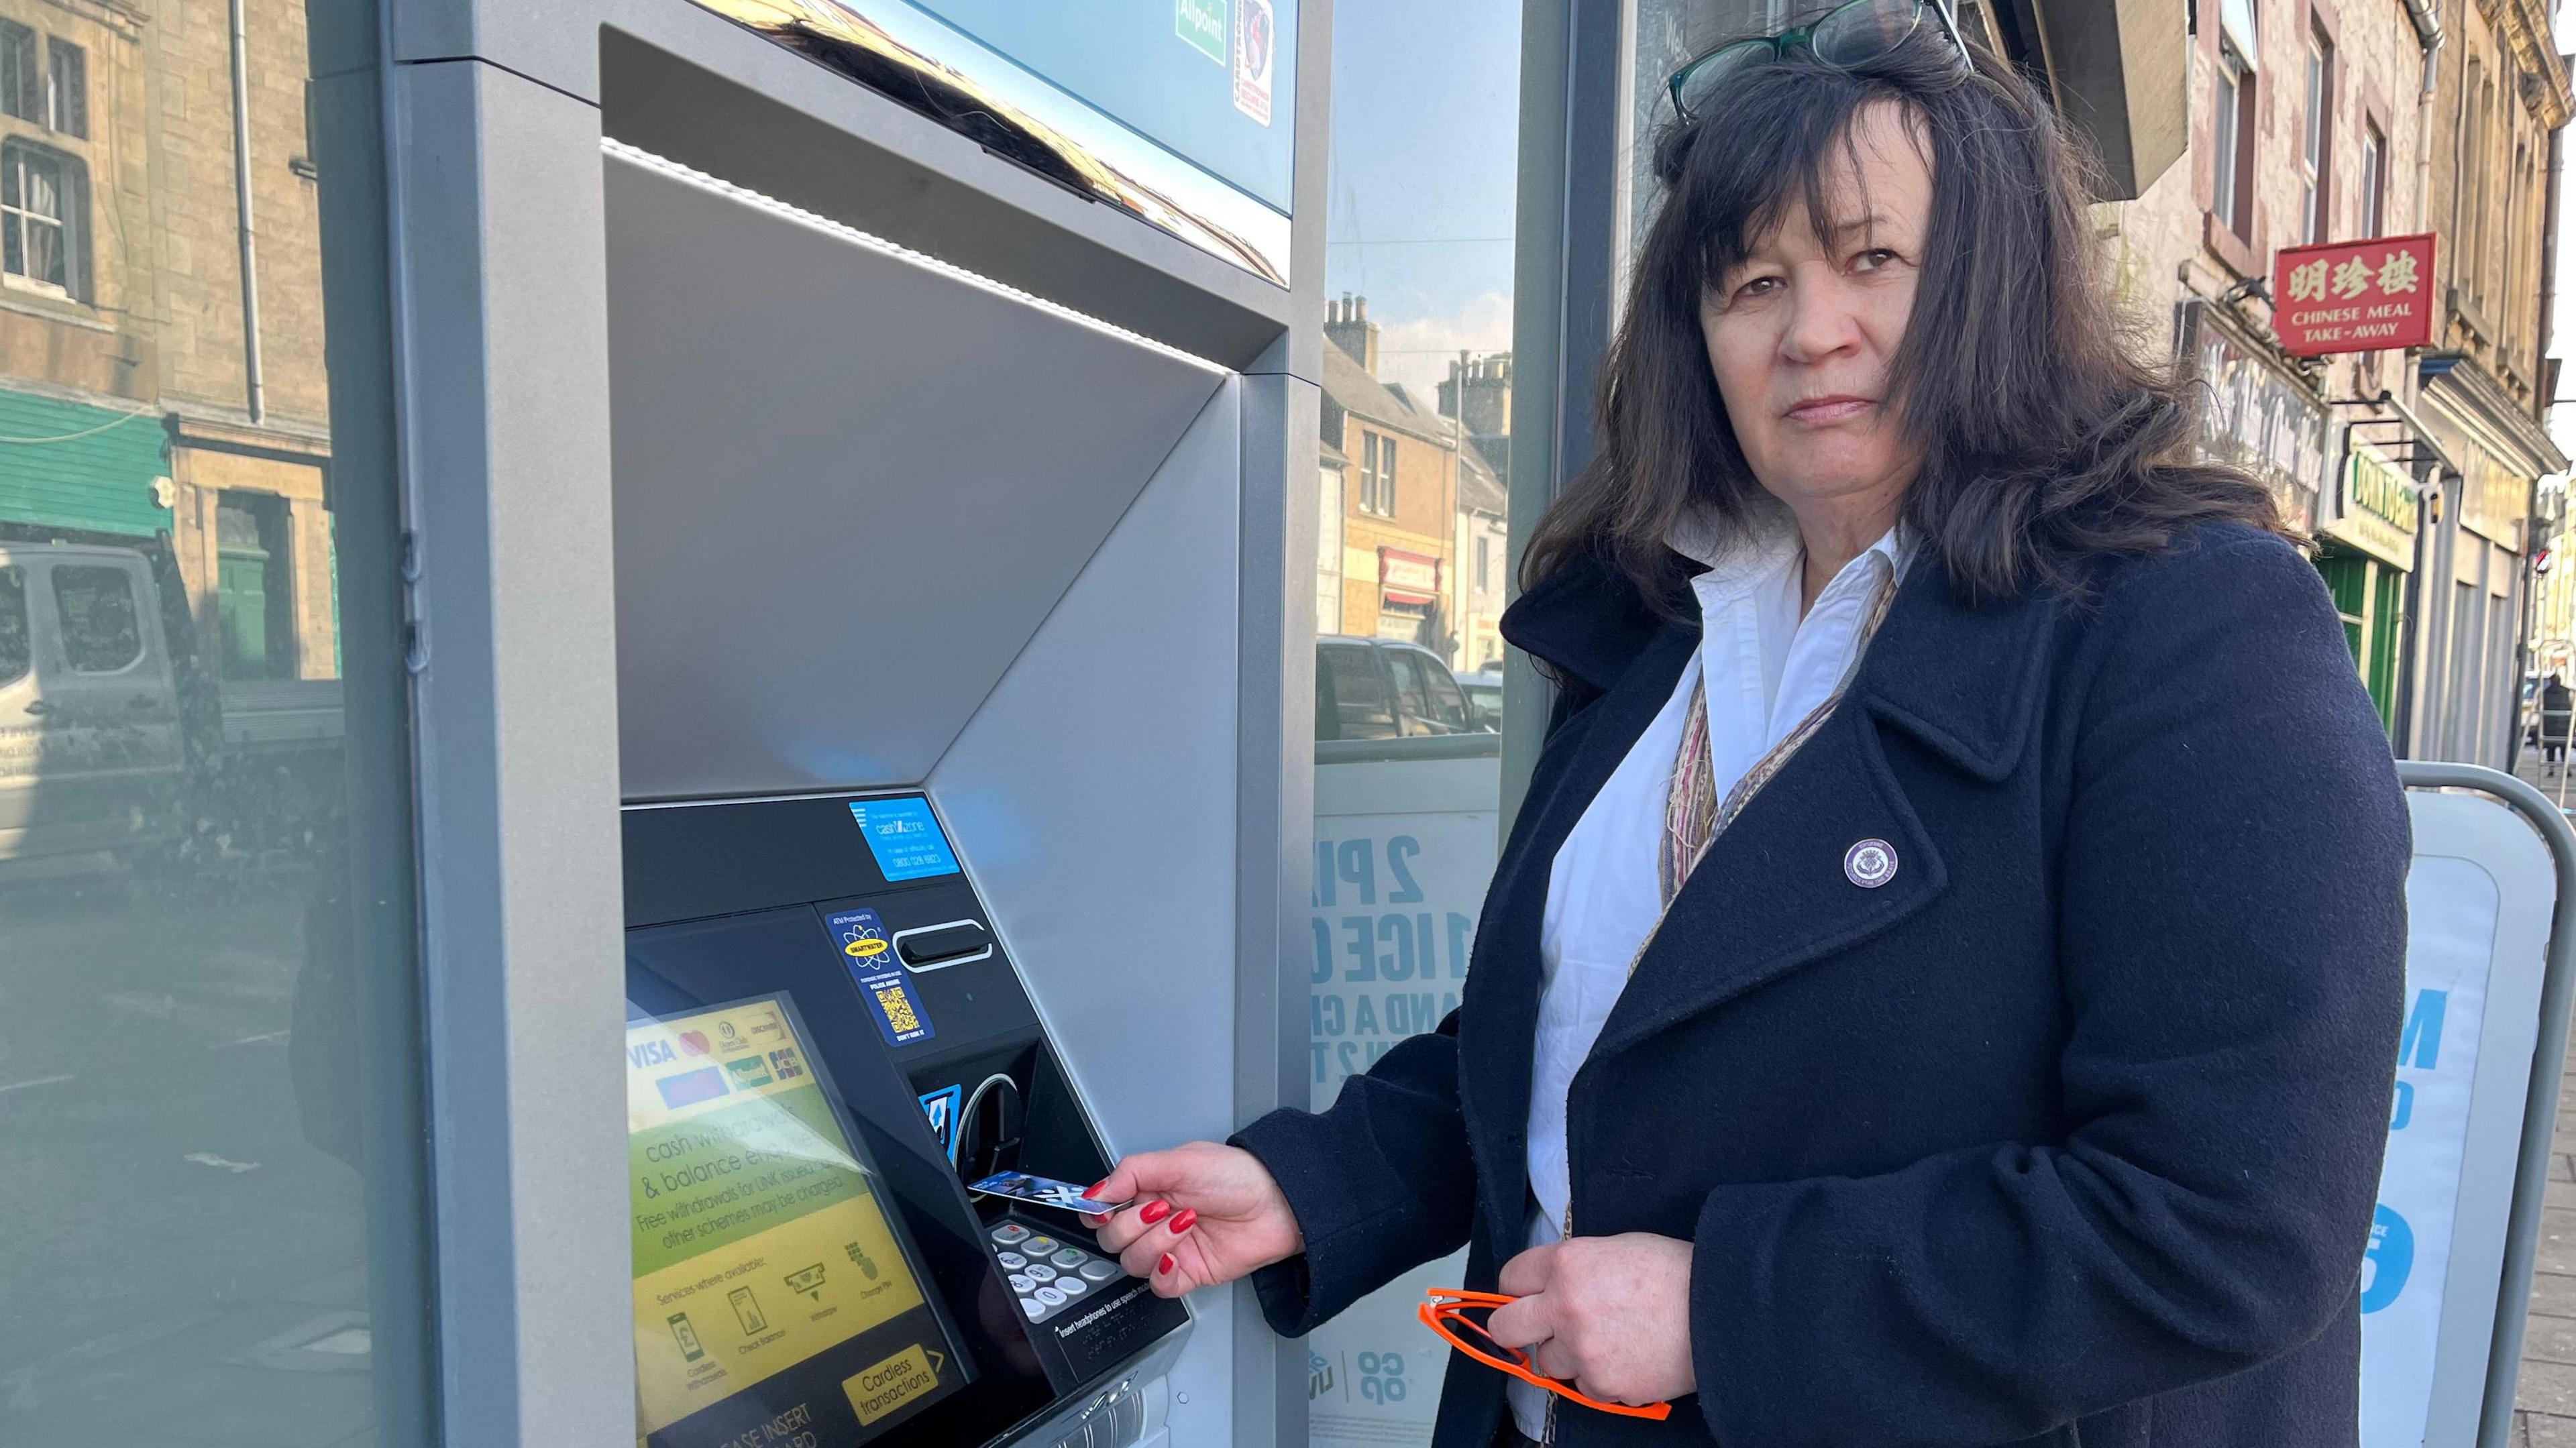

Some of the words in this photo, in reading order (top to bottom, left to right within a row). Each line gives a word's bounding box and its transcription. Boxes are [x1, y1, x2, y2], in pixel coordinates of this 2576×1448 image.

[1180, 0, 1223, 44] Allpoint
[2291, 307, 2361, 327] CHINESE
[2367, 302, 2412, 319] MEAL
[2303, 322, 2400, 343] TAKE-AWAY
[850, 942, 884, 954] SMARTWATER
[627, 1040, 678, 1069] VISA
[646, 1134, 693, 1162] cash
[641, 1177, 661, 1199] &
[660, 1156, 741, 1192] balance
[637, 1213, 667, 1232] Free
[667, 1186, 739, 1221] withdrawals
[737, 1182, 755, 1196] for
[663, 1227, 695, 1249] other
[697, 1209, 751, 1237] schemes
[750, 1199, 778, 1218] may
[777, 1192, 796, 1209] be
[796, 1174, 843, 1201] charged
[657, 1286, 696, 1306] Services
[695, 1274, 724, 1291] where
[1059, 1323, 1077, 1339] Insert
[1073, 1306, 1107, 1329] headphones
[1104, 1304, 1112, 1313] to
[1111, 1298, 1122, 1310] use
[1120, 1288, 1138, 1304] speech
[860, 1371, 930, 1415] transactions
[862, 1359, 912, 1392] Cardless
[761, 1402, 812, 1442] INSERT
